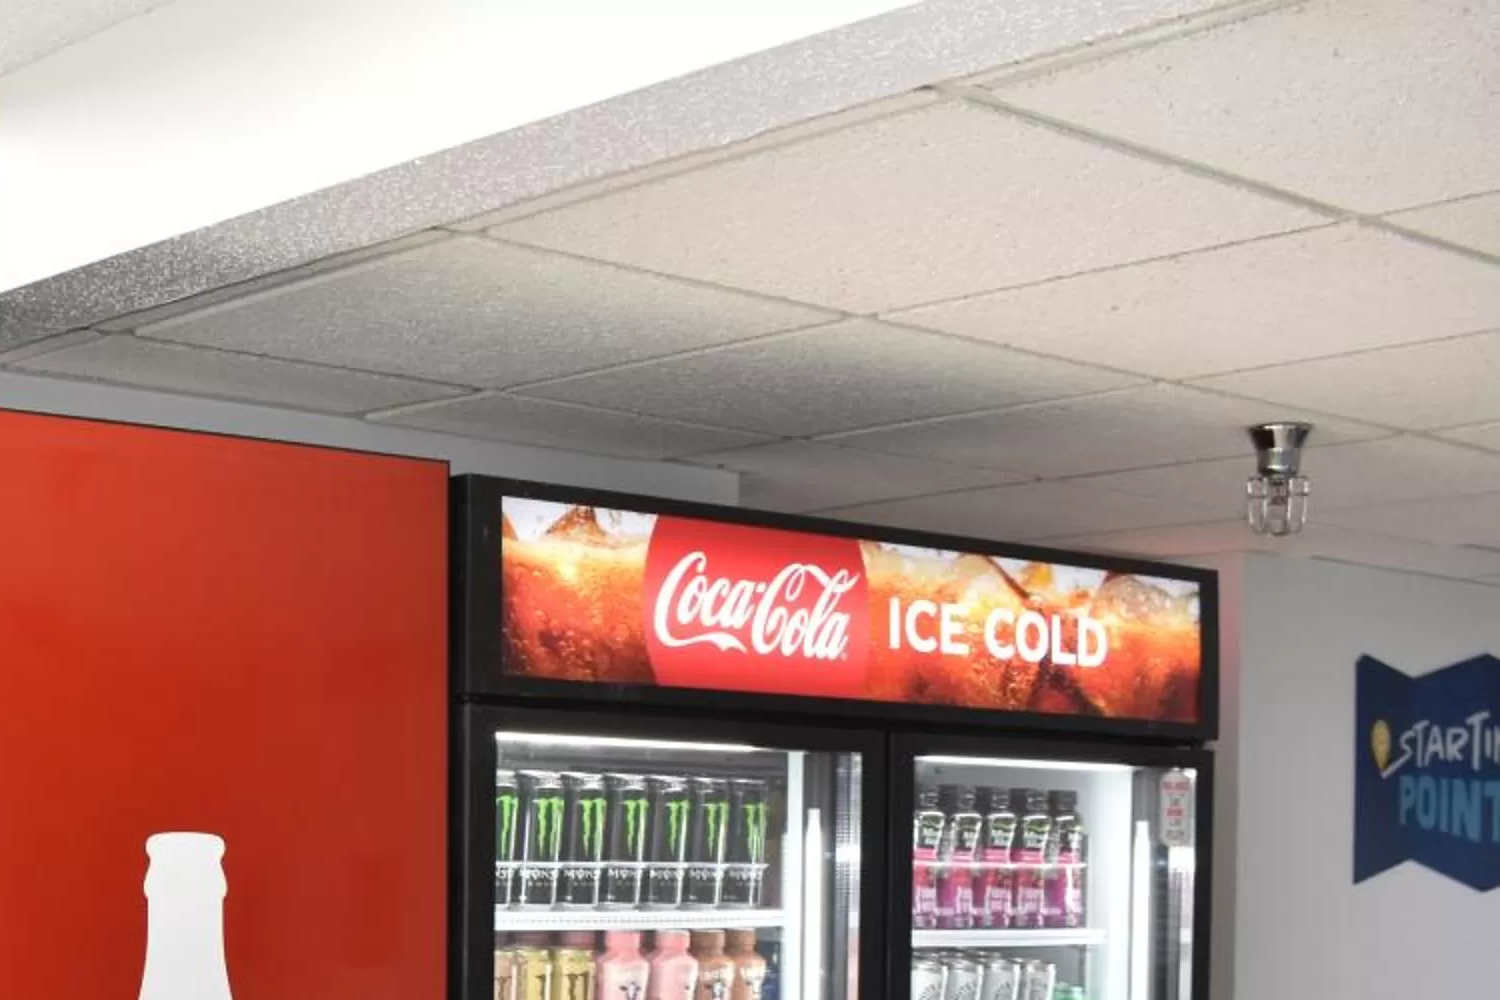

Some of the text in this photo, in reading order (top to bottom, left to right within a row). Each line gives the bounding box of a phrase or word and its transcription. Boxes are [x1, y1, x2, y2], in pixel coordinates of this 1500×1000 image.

[653, 549, 861, 661] Coca-Cola
[888, 595, 1109, 668] ICE COLD
